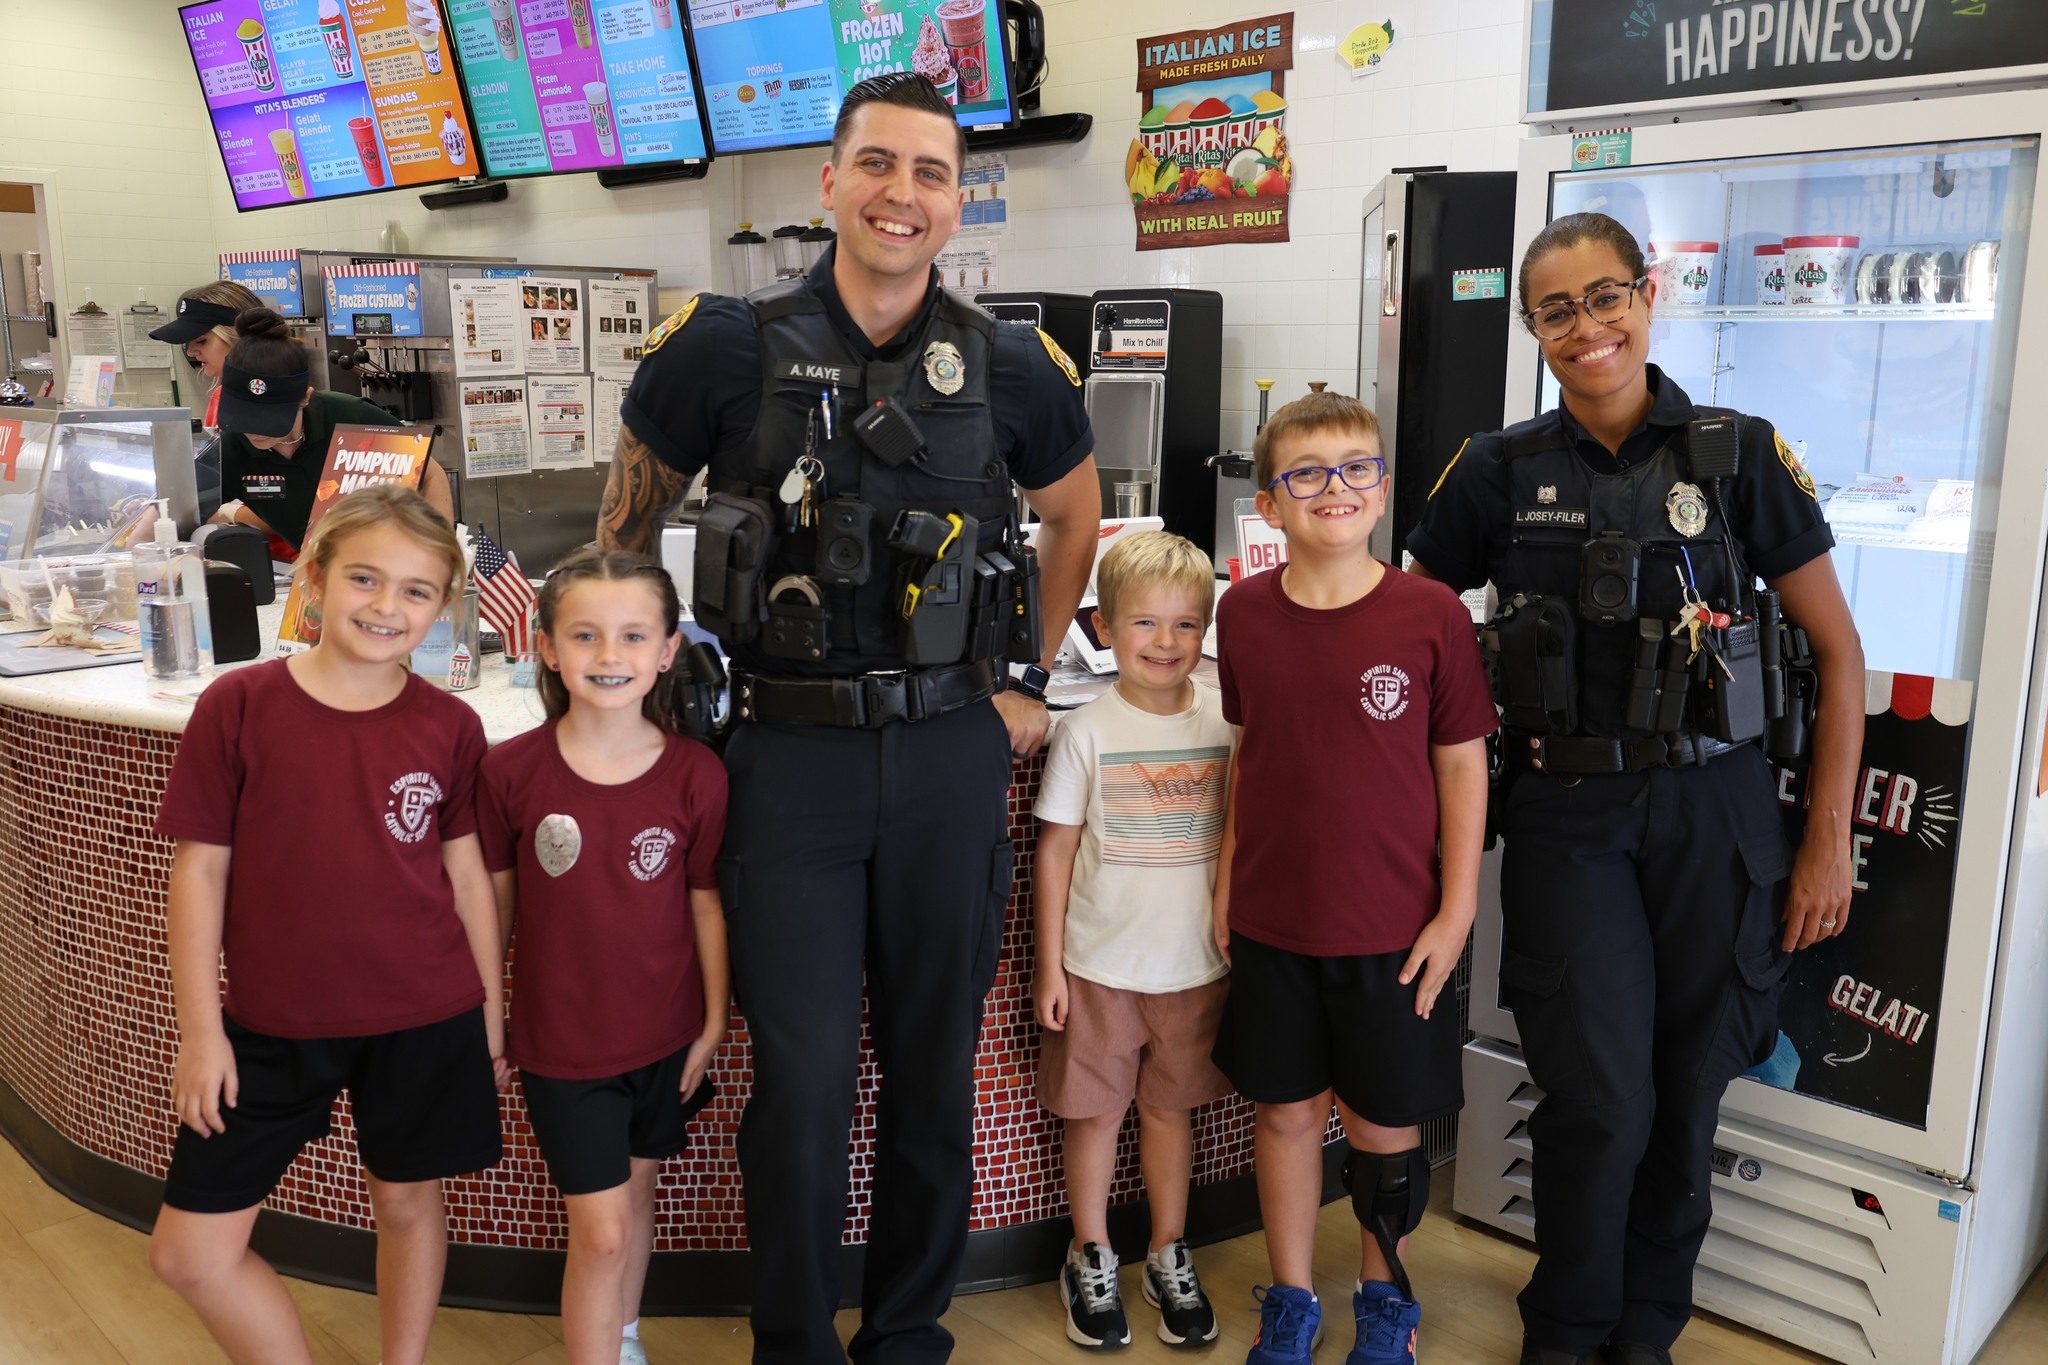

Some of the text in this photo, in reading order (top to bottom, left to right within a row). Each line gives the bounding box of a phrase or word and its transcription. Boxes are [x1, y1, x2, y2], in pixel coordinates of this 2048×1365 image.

[187, 11, 224, 29] ITALIAN
[714, 10, 727, 20] Splash
[841, 12, 904, 44] FROZEN
[191, 29, 207, 42] ICE
[1145, 25, 1282, 67] ITALIAN ICE
[1665, 0, 1926, 86] HAPPINESS!
[859, 39, 892, 65] HOT
[280, 60, 306, 70] 5-LAYER
[609, 56, 666, 76] TAKE HOME
[746, 62, 783, 77] TOPPINGS
[1159, 54, 1265, 80] MADE FRESH DAILY
[283, 69, 305, 78] GELATI
[536, 74, 558, 85] Frozen
[959, 67, 981, 79] Rita's
[471, 81, 509, 97] BLENDINI
[539, 84, 572, 97] Lemonade
[615, 86, 656, 100] SANDWICHES
[375, 91, 418, 107] SUNDAES
[254, 102, 280, 115] RITA'S
[295, 112, 321, 125] Gelati
[219, 129, 232, 139] Ice
[298, 124, 332, 137] Blender
[624, 132, 641, 142] PINTS
[222, 138, 253, 150] Blender
[1199, 149, 1221, 163] Rita's
[1141, 210, 1283, 235] WITH REAL FRUIT
[1687, 273, 1707, 285] Rita's
[1769, 275, 1785, 285] Rita
[1798, 269, 1824, 281] Rita's
[258, 277, 287, 291] CUSTARD
[353, 283, 387, 292] Old-Fashioned
[339, 294, 404, 308] FROZEN CUSTARD
[1146, 338, 1163, 346] Chill
[790, 364, 840, 381] A. KAYE
[333, 449, 414, 476] PUMPKIN
[1525, 511, 1585, 523] JOSEY-FILER
[1360, 664, 1410, 686] ESPIRITU SANTO
[1360, 697, 1408, 721] CATHOLIC SCHOOL
[389, 772, 430, 795] ESPIRITU
[384, 812, 415, 843] CATHOLIC
[630, 827, 662, 847] ESPIRITU
[628, 859, 651, 882] CATHOLIC
[1829, 973, 1931, 1046] GELATI
